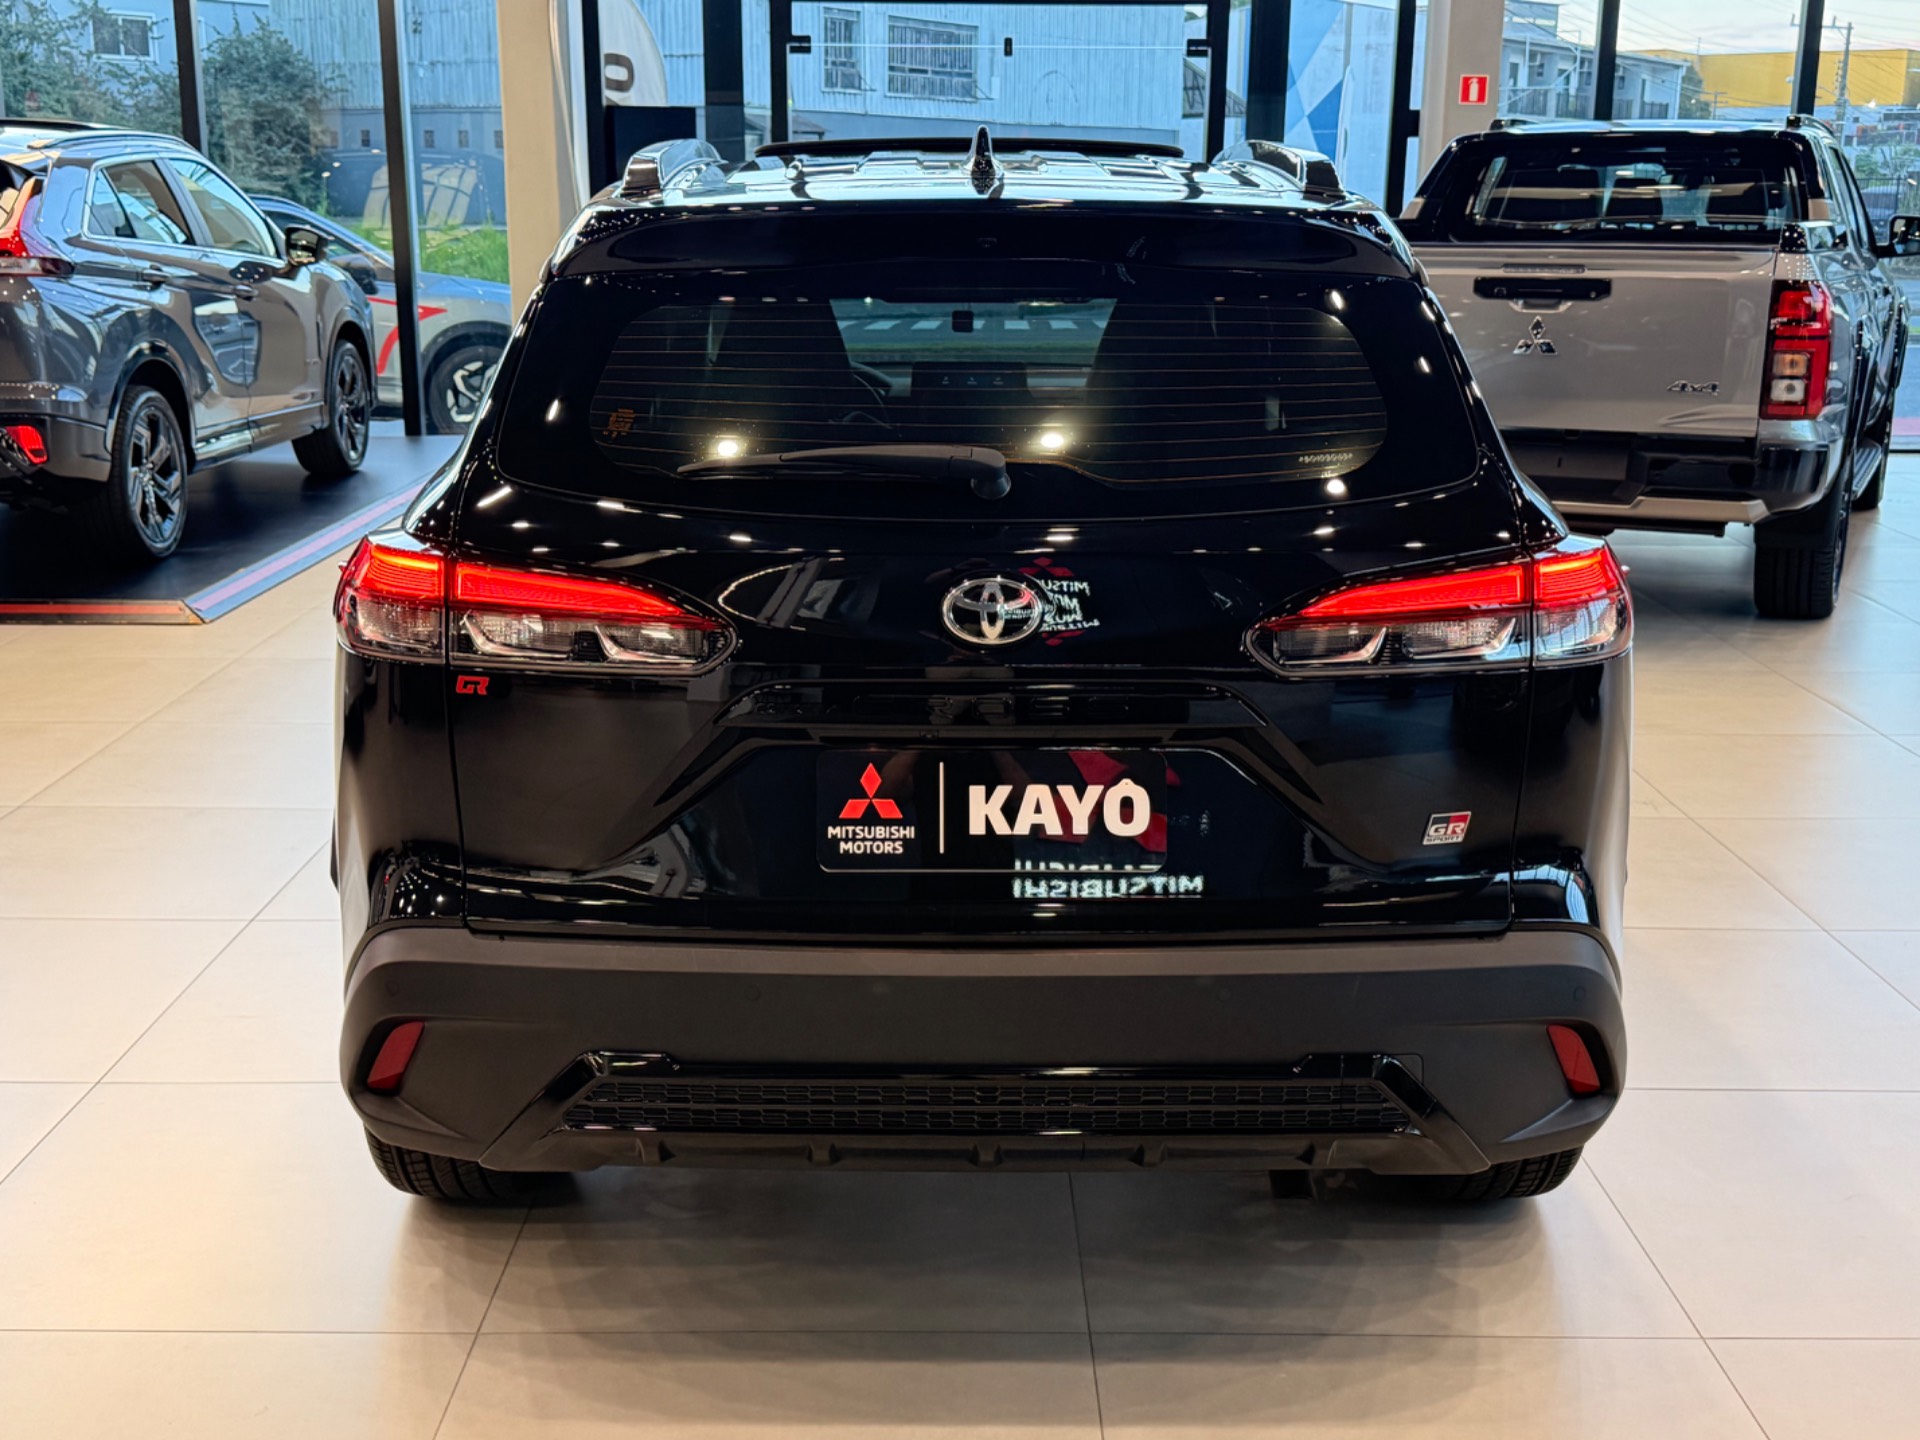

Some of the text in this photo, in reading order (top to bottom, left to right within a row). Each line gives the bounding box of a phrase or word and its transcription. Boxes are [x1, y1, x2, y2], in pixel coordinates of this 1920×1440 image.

[456, 675, 489, 695] GR
[828, 825, 915, 839] MITSUBISHI
[1429, 822, 1465, 836] GR
[839, 841, 904, 854] MOTORS
